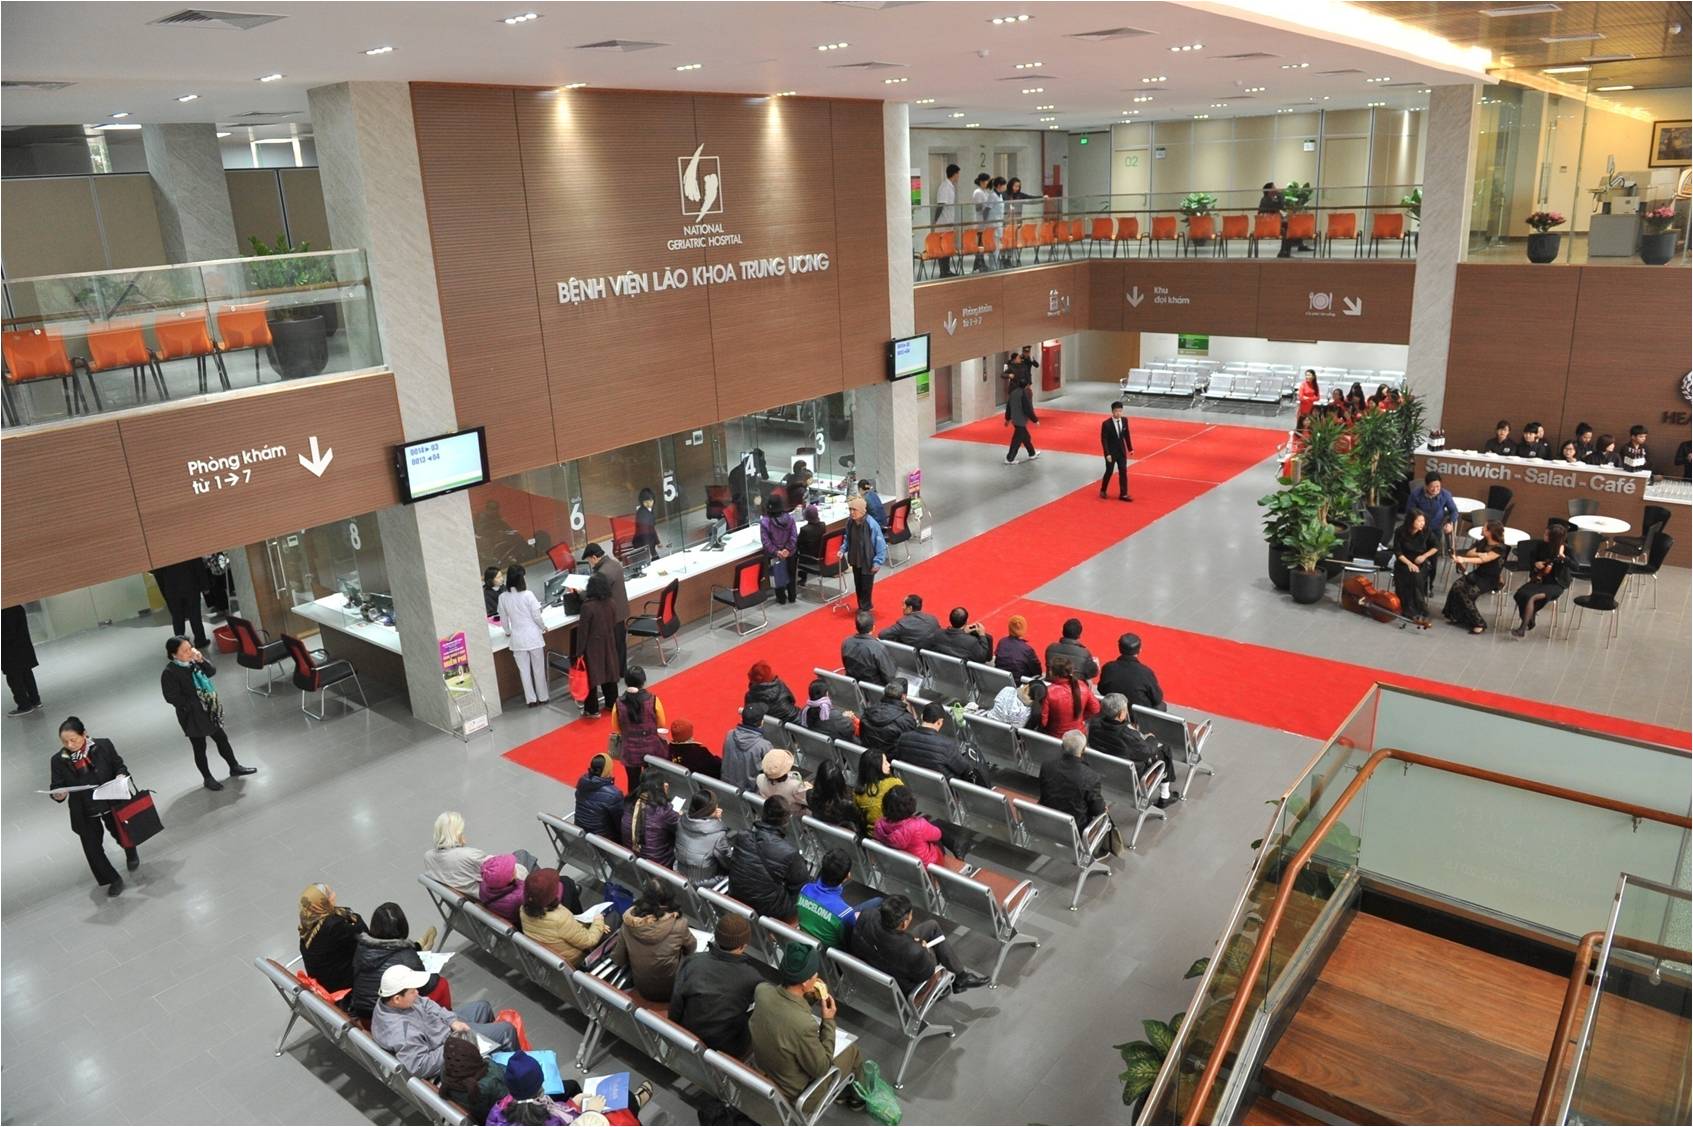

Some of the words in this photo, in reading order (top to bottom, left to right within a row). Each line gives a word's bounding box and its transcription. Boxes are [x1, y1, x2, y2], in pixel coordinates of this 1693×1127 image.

[667, 236, 706, 251] GERIATRIC
[708, 233, 743, 247] HOSPITAL
[683, 223, 724, 236] NATIONAL
[557, 277, 607, 306] BỆNH
[608, 270, 648, 298] VIỆN
[652, 266, 689, 292] LÃO
[692, 263, 737, 286] KHOA
[740, 257, 786, 280] TRUNG
[788, 252, 830, 274] ƯƠNG
[815, 432, 825, 455] 3
[187, 456, 240, 476] Phòng
[241, 444, 287, 464] khám
[745, 453, 756, 477] 4
[192, 478, 210, 495] từ
[214, 475, 222, 490] 1
[242, 468, 251, 484] 7
[663, 476, 676, 502] 5
[1425, 457, 1511, 480] Sandwich
[1524, 468, 1576, 488] Salad
[1589, 474, 1636, 495] Café
[570, 502, 584, 531] 6
[349, 522, 361, 550] 8
